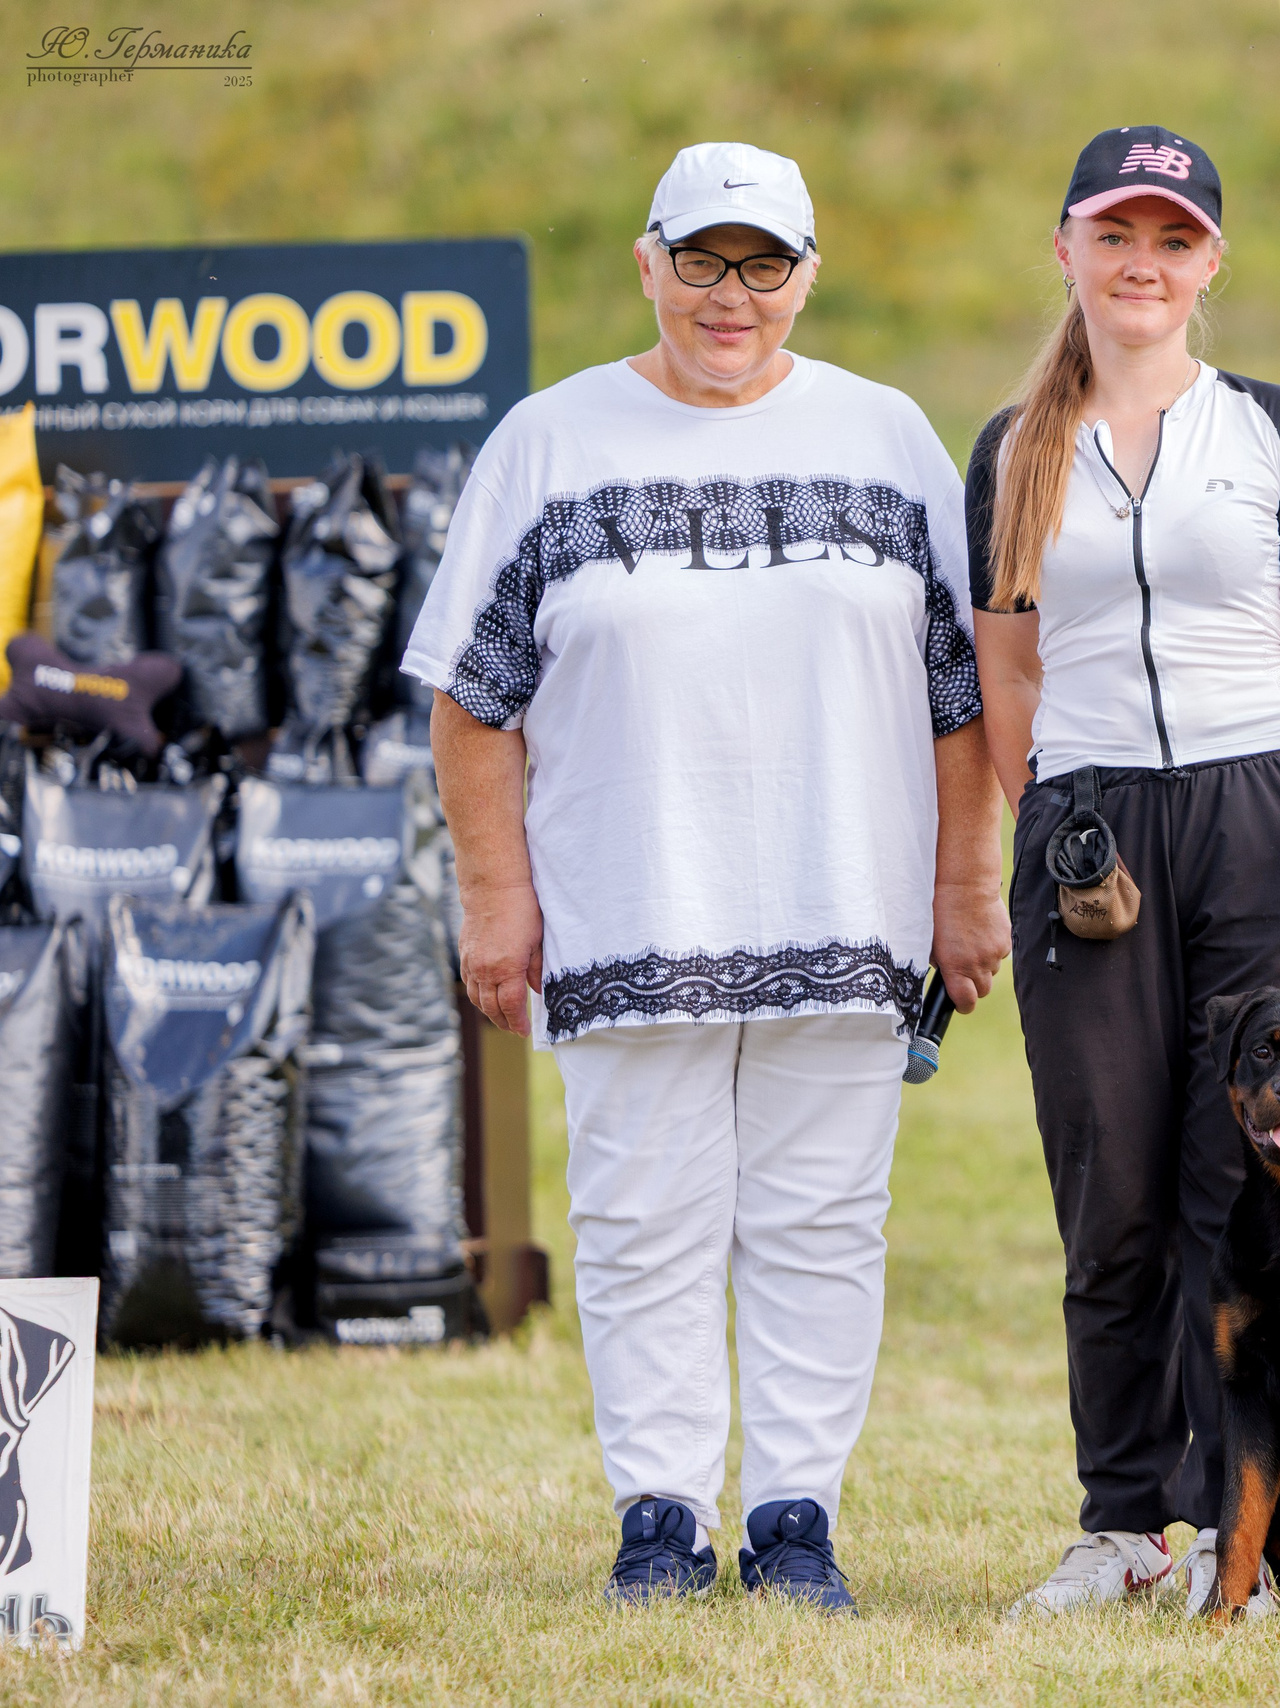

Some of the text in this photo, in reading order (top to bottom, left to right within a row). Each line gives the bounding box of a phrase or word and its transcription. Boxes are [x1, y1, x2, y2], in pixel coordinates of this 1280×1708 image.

[102, 397, 178, 430] СУХОЙ
[179, 397, 248, 429] КОРМ
[246, 396, 299, 428] ДЛЯ
[34, 664, 130, 701] KORWOOD
[35, 839, 179, 878] KORWOOD
